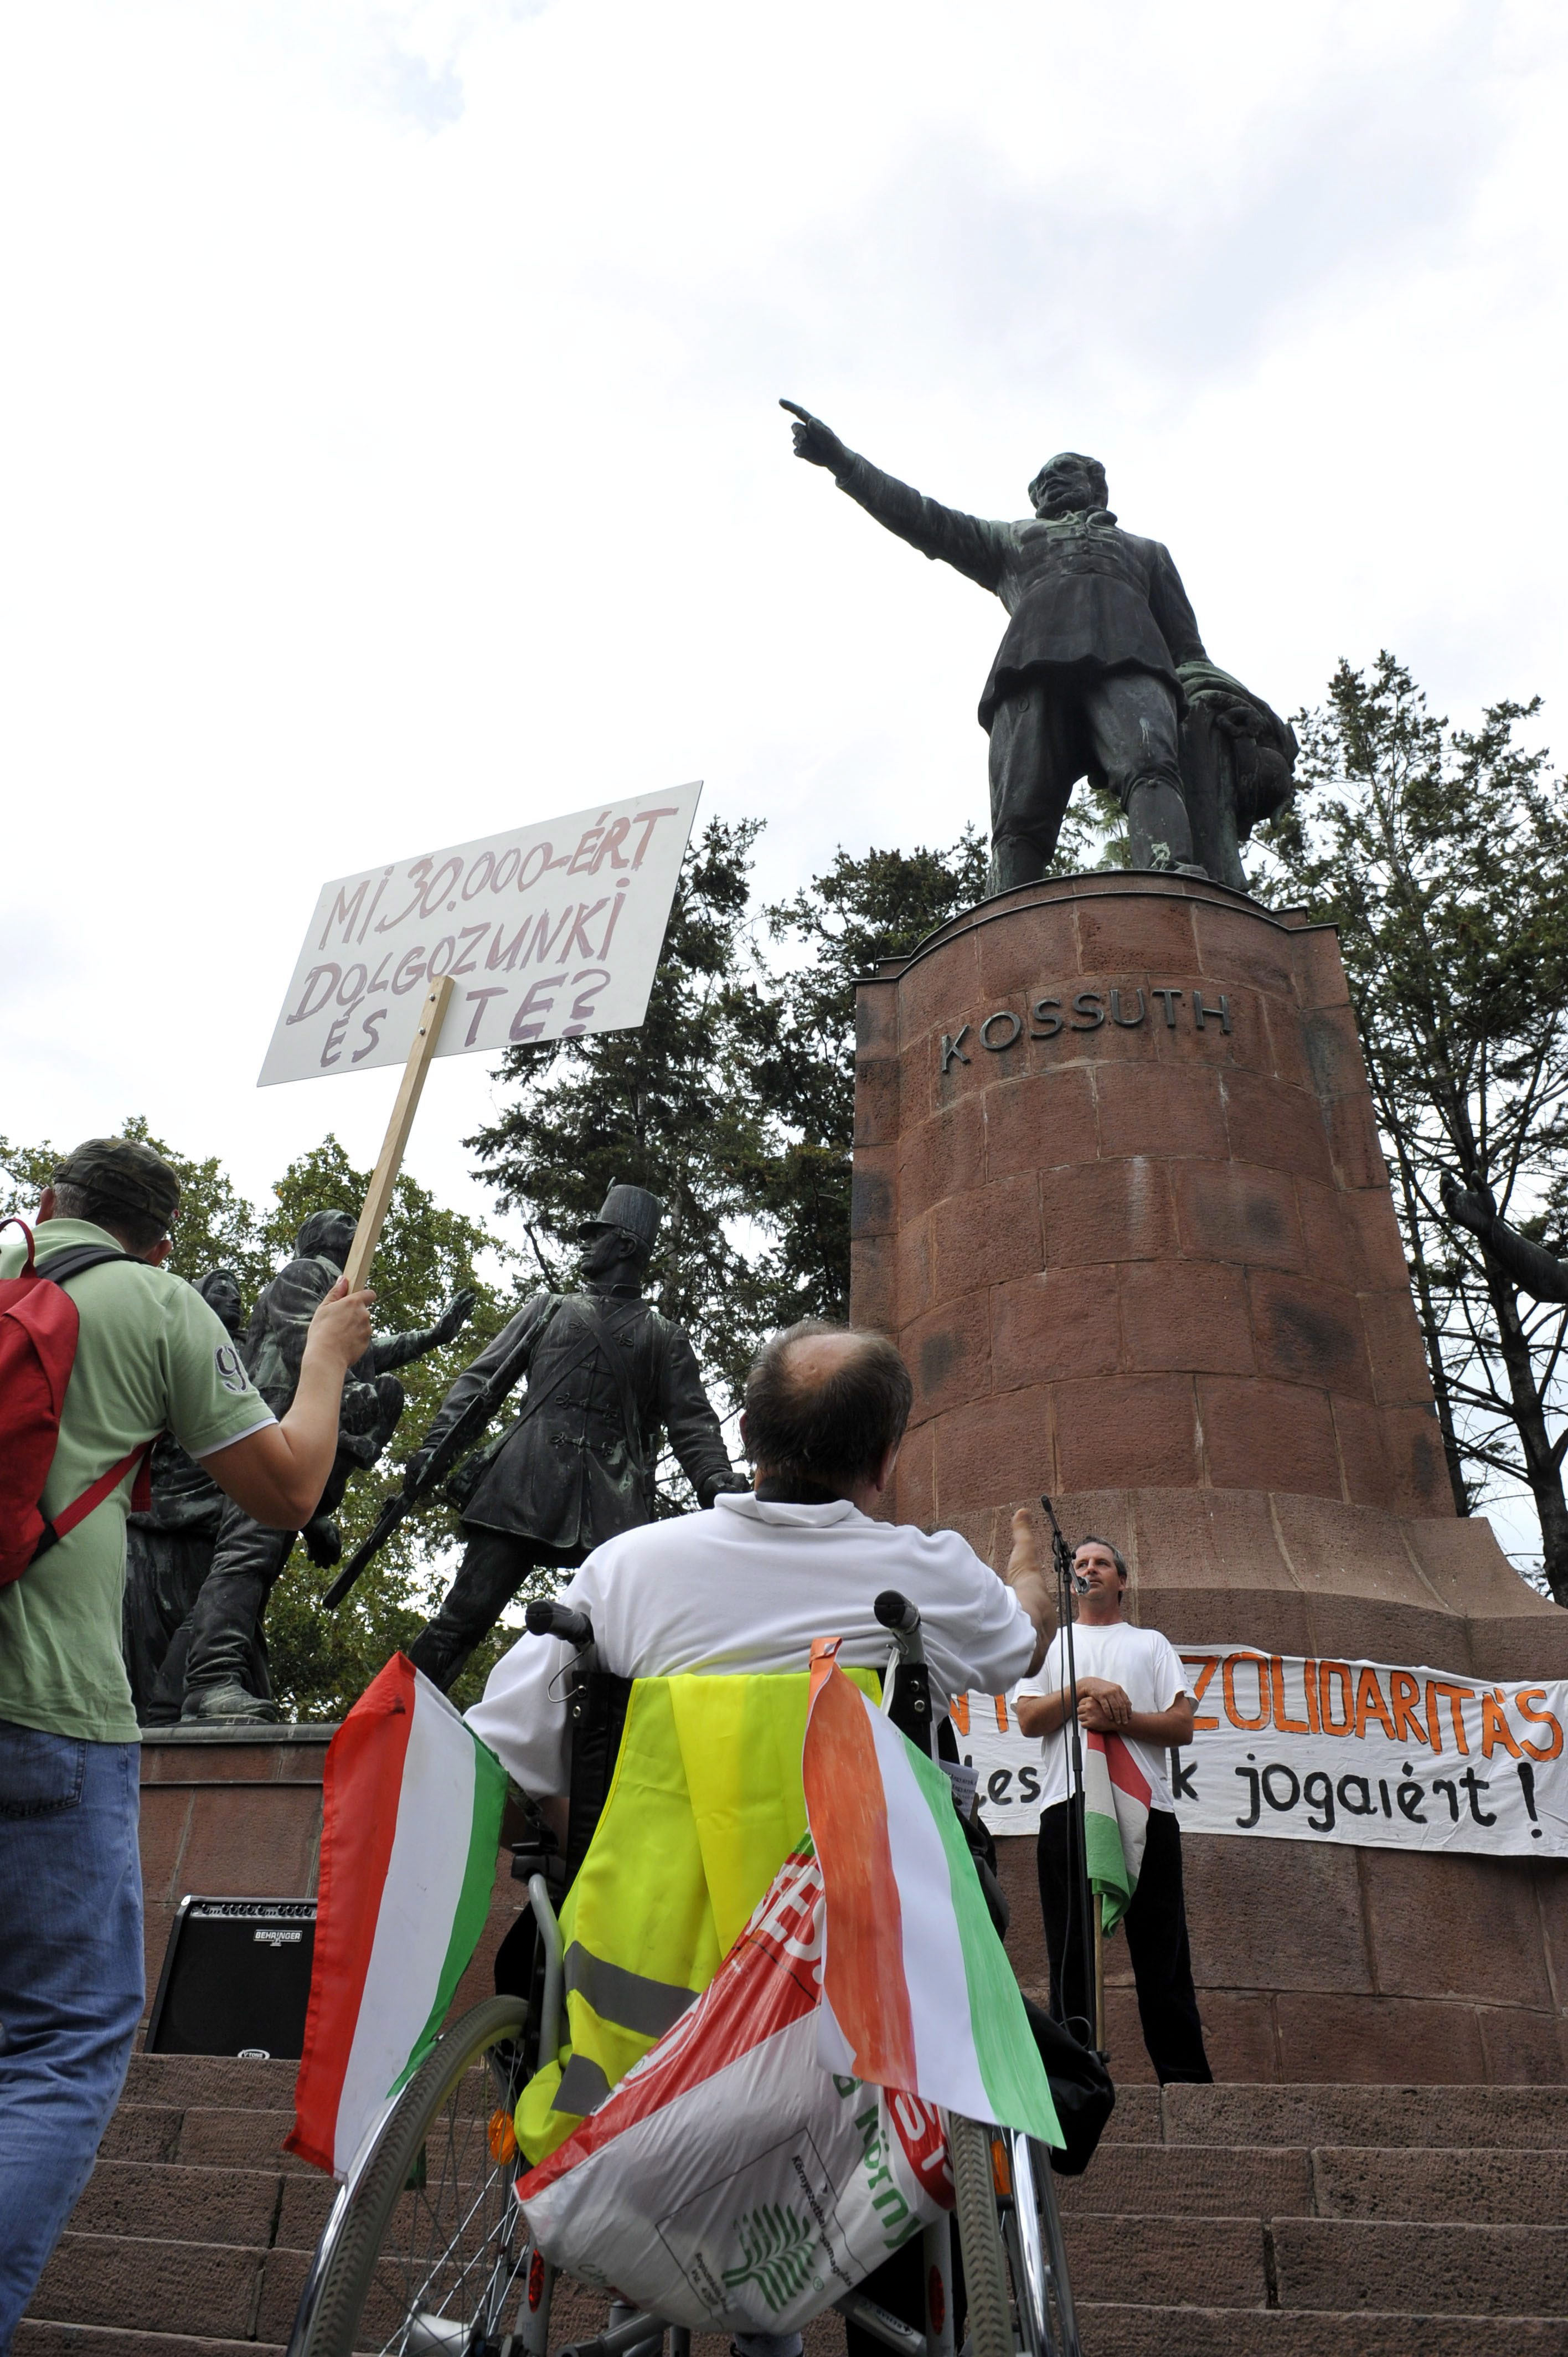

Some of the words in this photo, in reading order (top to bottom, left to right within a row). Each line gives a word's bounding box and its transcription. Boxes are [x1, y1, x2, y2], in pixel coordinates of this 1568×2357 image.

[320, 995, 388, 1068] ÉS
[464, 969, 612, 1048] TE?
[941, 987, 1232, 1074] KOSSUTH
[1179, 1651, 1564, 1762] ZOLIDARITÁS
[255, 1931, 301, 1941] BEHRINGER
